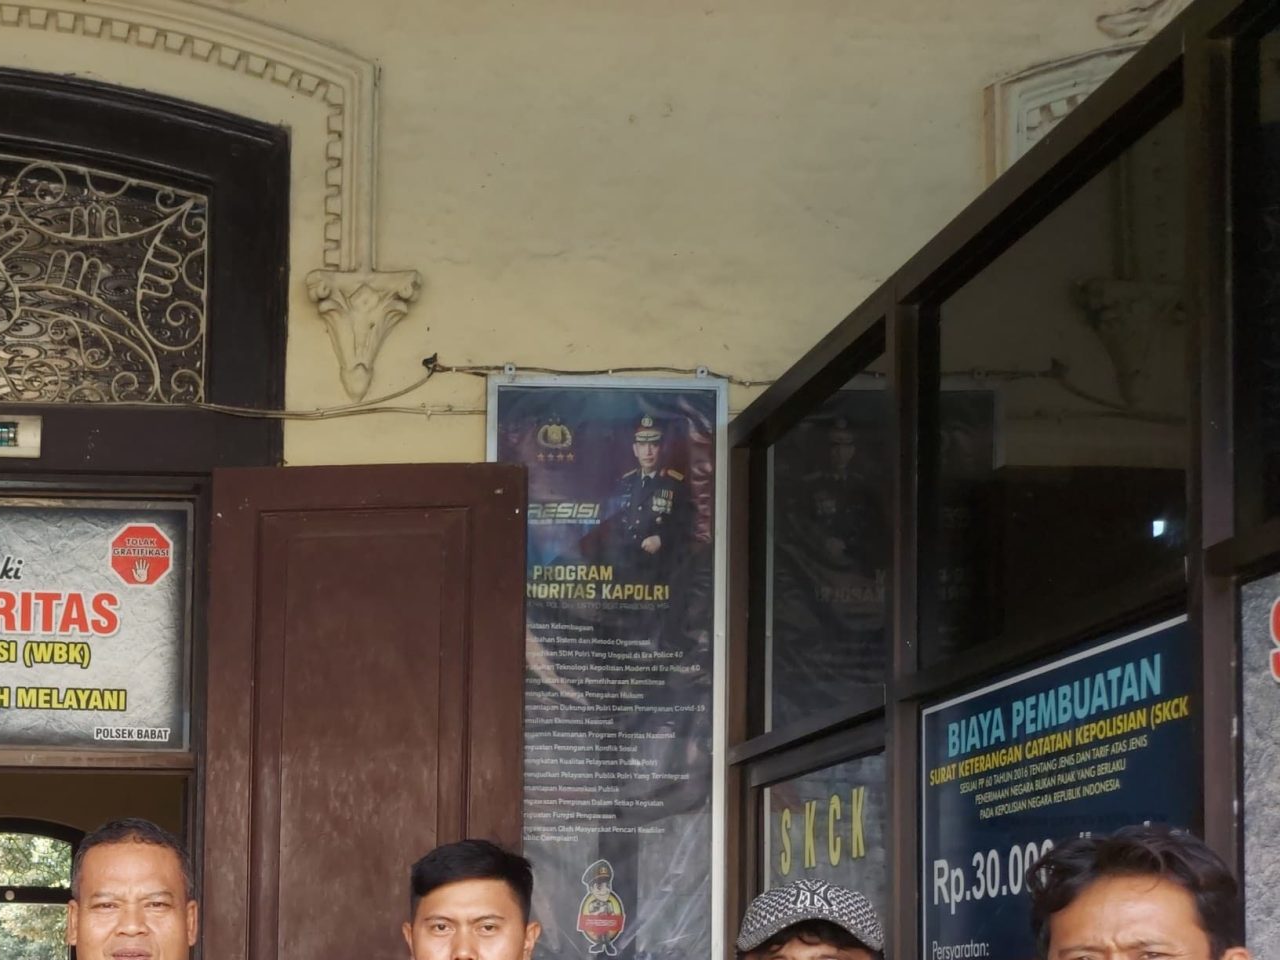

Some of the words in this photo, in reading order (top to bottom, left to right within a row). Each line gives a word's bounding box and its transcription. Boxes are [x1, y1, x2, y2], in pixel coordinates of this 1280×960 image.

[527, 503, 600, 518] RESISI
[126, 538, 157, 546] TOLAK
[532, 564, 613, 581] PROGRAM
[526, 583, 596, 599] IORITAS
[602, 584, 670, 600] KAPOLRI
[23, 641, 91, 668] (WBK)
[17, 687, 128, 711] MELAYANI
[947, 706, 1007, 758] BIAYA
[1010, 653, 1163, 739] PEMBUATAN
[94, 727, 135, 741] POLSEK
[136, 728, 170, 742] BABAT
[929, 763, 958, 787] SURAT
[958, 748, 1023, 778] KETERANGAN
[1024, 729, 1073, 760] CATATAN
[1075, 710, 1148, 747] KEPOLISIAN
[1150, 695, 1190, 732] (SKCK
[993, 770, 1012, 786] TAHUN
[1013, 767, 1029, 781] 2016
[1029, 758, 1058, 776] TENTANG
[1057, 754, 1075, 771] JENIS
[1076, 750, 1091, 765] DAN
[1091, 744, 1110, 761] TARIF
[1109, 740, 1128, 756] ATAS
[1128, 735, 1149, 752] JENIS
[1010, 781, 1035, 798] NEGARA
[1035, 774, 1057, 791] BUKAN
[1057, 768, 1076, 785] PAJAK
[1076, 765, 1096, 782] YANG
[1096, 758, 1127, 777] BERLAKU
[979, 806, 994, 820] PADA
[994, 797, 1028, 818] KEPOLISIAN
[1028, 792, 1053, 810] NEGARA
[1053, 787, 1081, 806] REPUBLIK
[1082, 779, 1121, 798] INDONESIA
[780, 785, 866, 876] SKCK
